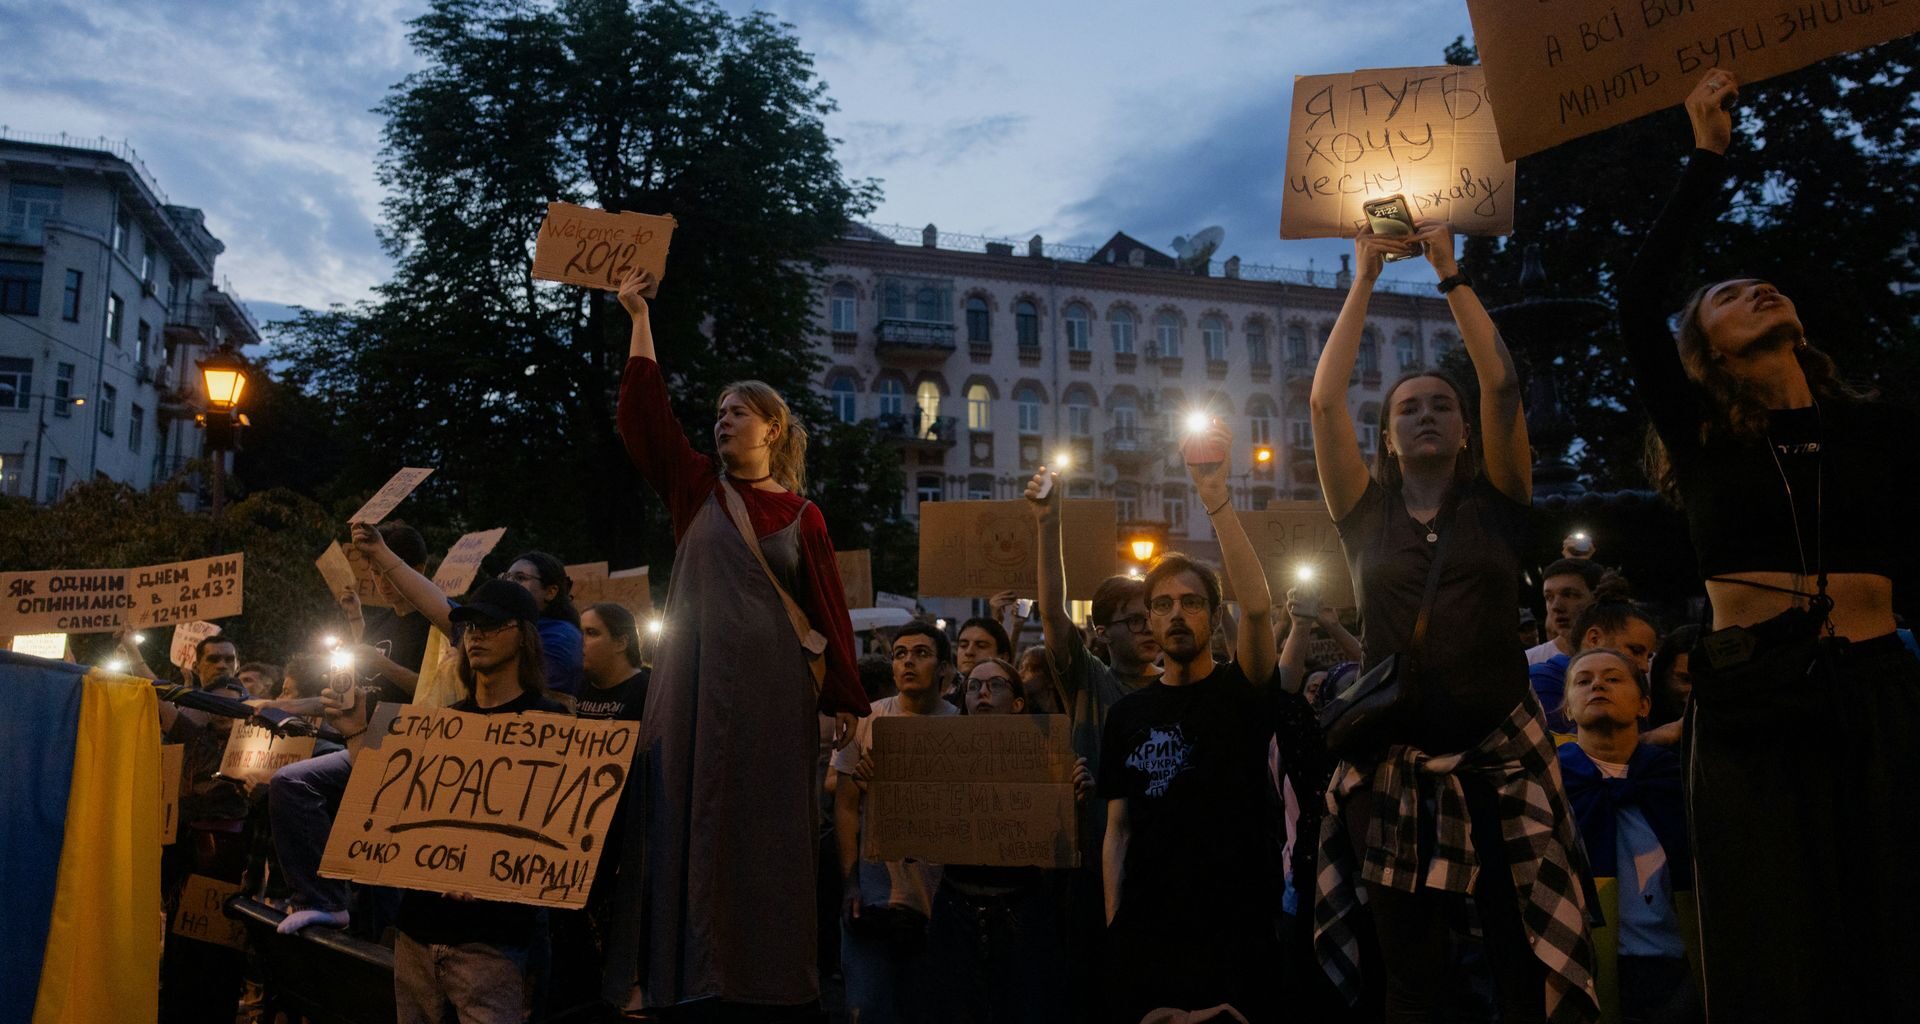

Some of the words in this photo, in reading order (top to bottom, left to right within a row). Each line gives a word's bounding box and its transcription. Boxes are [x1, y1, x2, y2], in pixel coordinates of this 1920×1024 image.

[1546, 35, 1564, 68] А
[1579, 9, 1624, 52] ВСІ
[1559, 64, 1660, 123] МАЮТЬ
[1676, 23, 1766, 75] БУТИ
[1304, 83, 1336, 134] Я
[1349, 76, 1438, 122] ТУТ
[1374, 206, 1399, 217] 21:22
[547, 218, 625, 241] Welcome
[631, 225, 654, 245] to
[563, 238, 637, 285] 2012
[7, 578, 37, 598] ЯК
[48, 575, 125, 593] ОДНИМ
[136, 567, 190, 589] ДНЕМ
[206, 560, 237, 579] МИ
[17, 594, 137, 614] ОПИНИЛИСЬ
[57, 614, 121, 629] CANCEL
[139, 603, 198, 624] #12414
[387, 715, 464, 740] СТАЛО
[485, 722, 630, 758] НЕЗРУЧНО
[878, 783, 1004, 817] СИСТЕМА
[347, 839, 401, 864] ОЧКО
[414, 844, 468, 872] СОБІ
[489, 849, 590, 900] ВКРАДИ
[181, 911, 209, 935] НА
